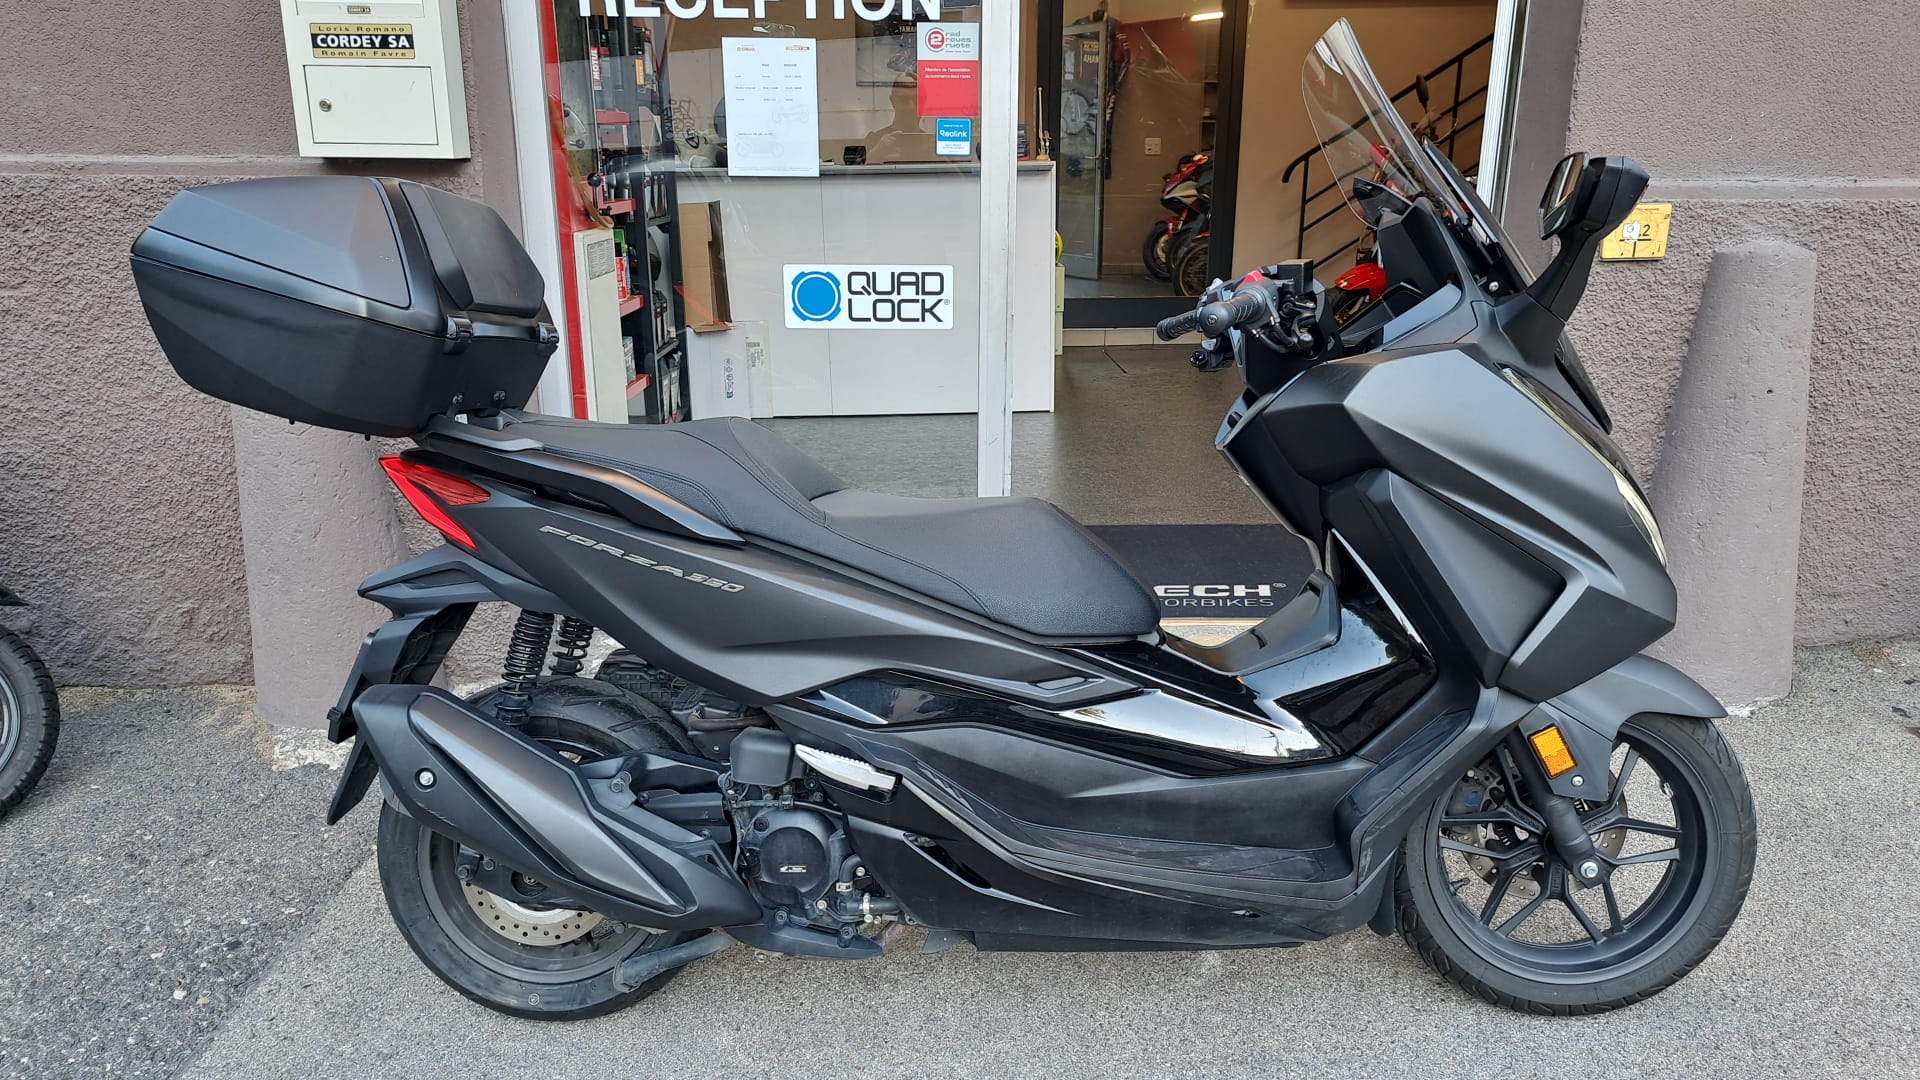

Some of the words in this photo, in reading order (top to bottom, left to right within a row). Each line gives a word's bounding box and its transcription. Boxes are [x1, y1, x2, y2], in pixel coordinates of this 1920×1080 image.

[316, 34, 383, 48] CORDEY
[387, 35, 410, 48] SA
[591, 48, 601, 82] MOTUL
[847, 271, 945, 296] QUAD
